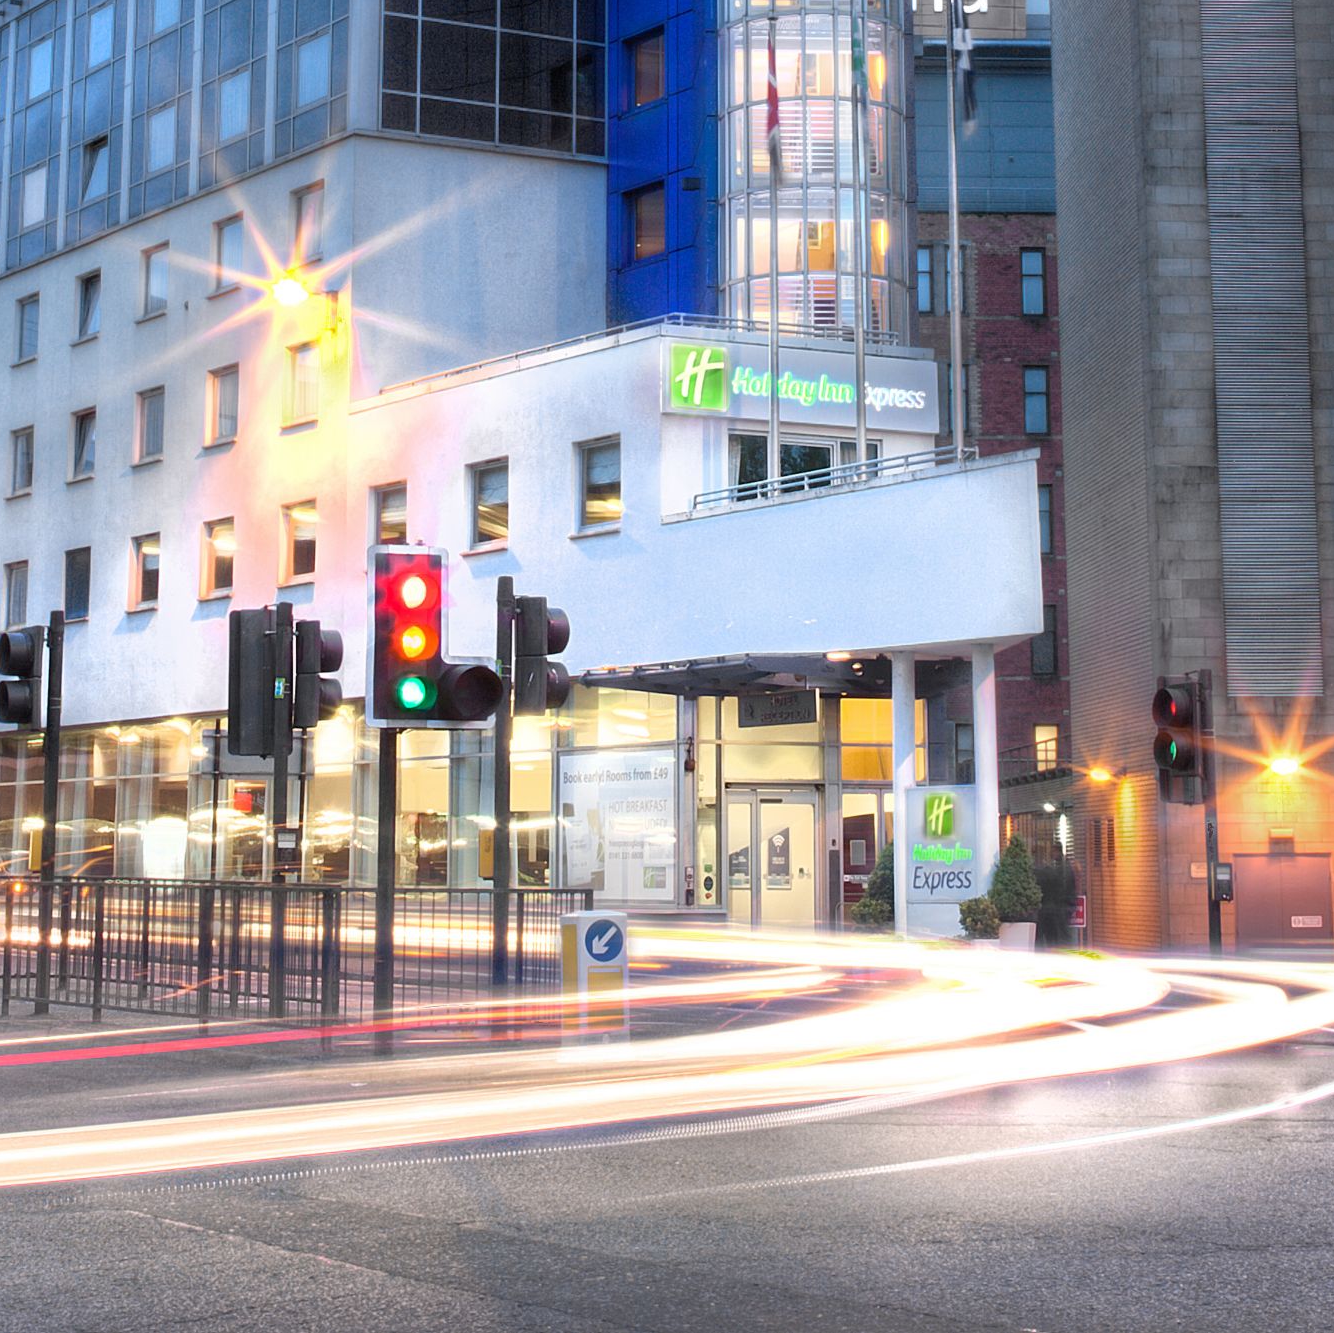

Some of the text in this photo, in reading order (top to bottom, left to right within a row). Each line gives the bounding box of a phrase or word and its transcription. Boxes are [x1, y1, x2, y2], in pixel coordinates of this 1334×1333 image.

[731, 366, 926, 412] Holday Inn xpress
[563, 767, 668, 786] Book early! Rooms from £49
[608, 799, 668, 814] HOT BREAKFAST
[913, 842, 973, 865] Holiday Inn
[913, 866, 972, 895] Express
